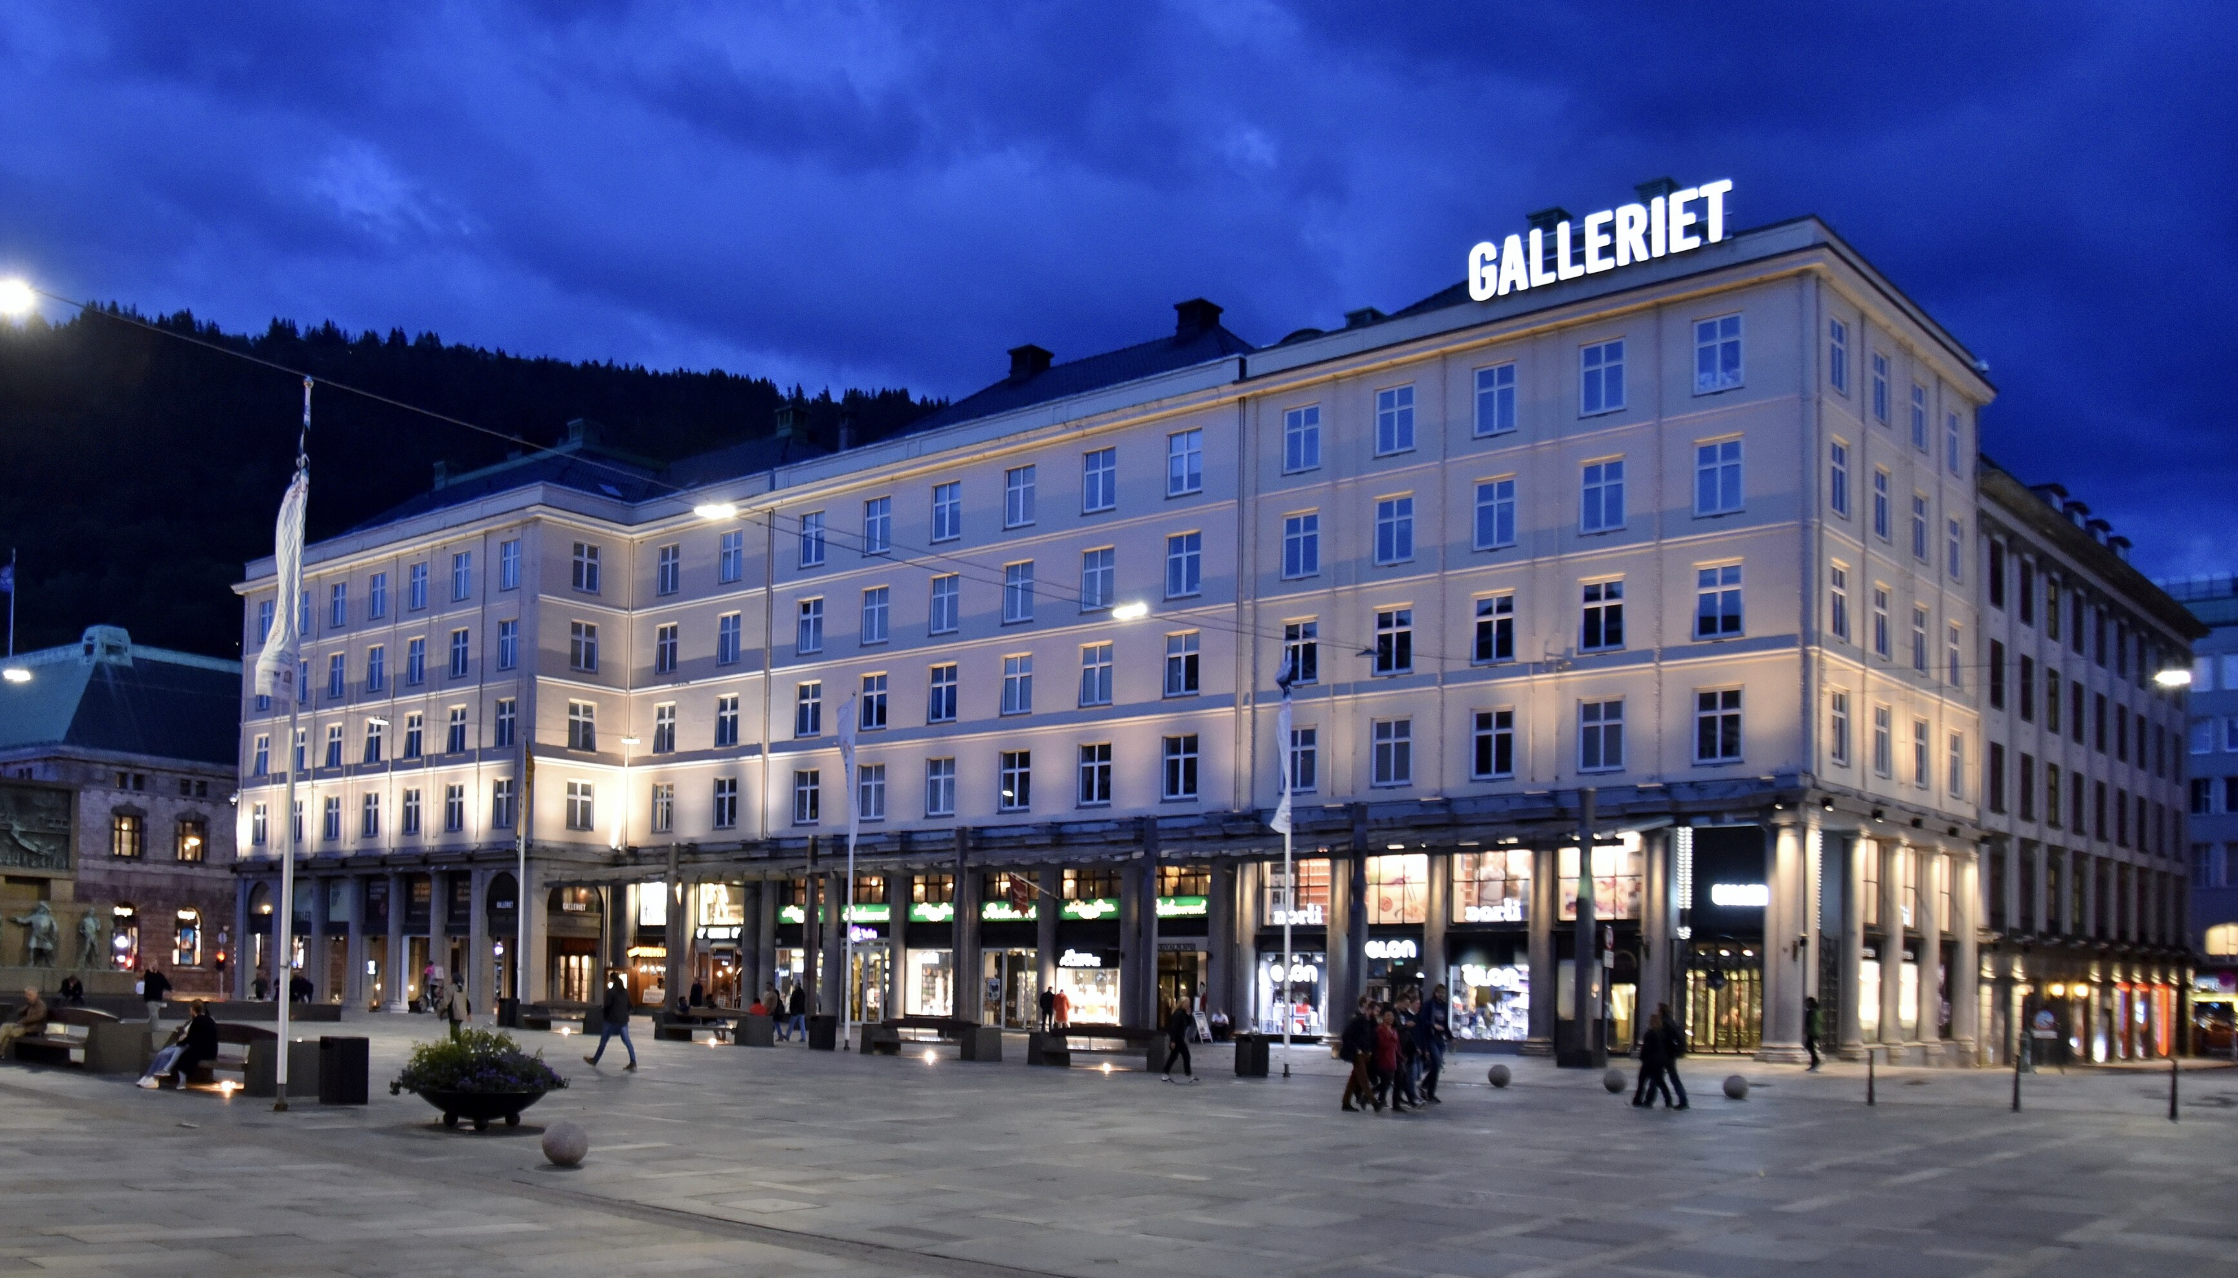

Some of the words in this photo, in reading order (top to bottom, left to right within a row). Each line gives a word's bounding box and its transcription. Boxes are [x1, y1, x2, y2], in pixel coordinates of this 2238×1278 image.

[1468, 179, 1733, 302] GALLERIET
[562, 902, 587, 912] GALLERIET
[1465, 897, 1523, 922] norli
